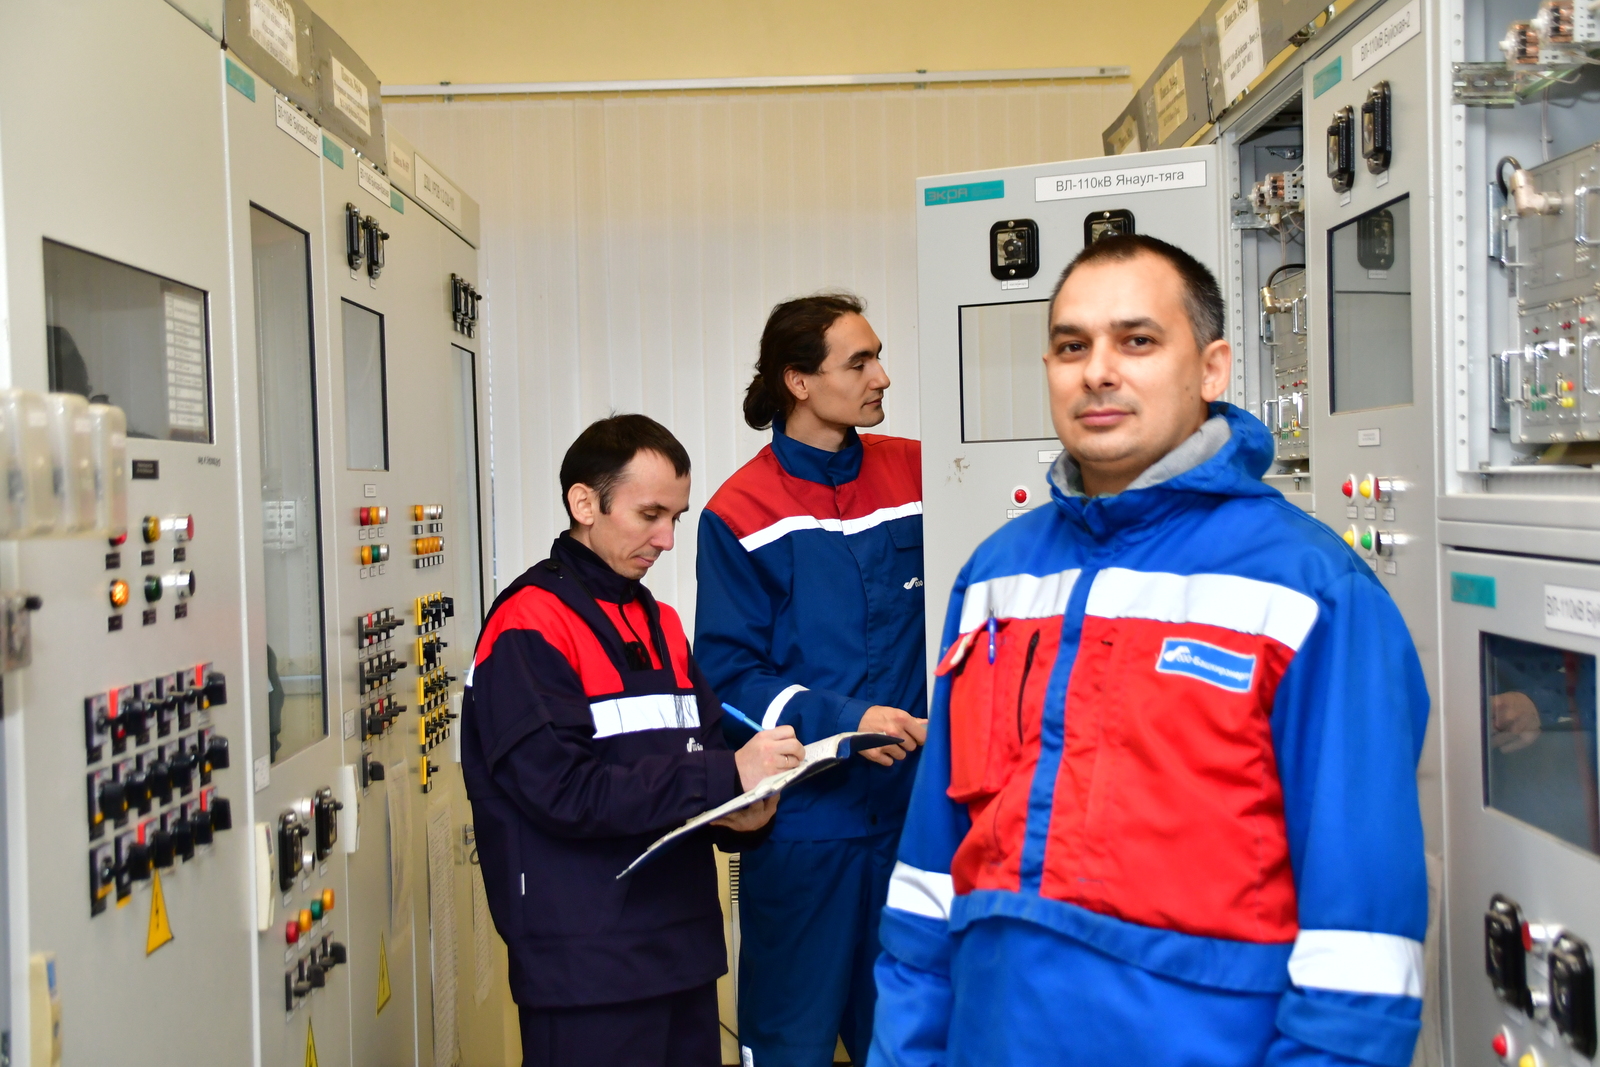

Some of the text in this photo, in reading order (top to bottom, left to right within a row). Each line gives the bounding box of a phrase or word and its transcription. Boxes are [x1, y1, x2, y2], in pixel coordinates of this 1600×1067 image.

[1361, 11, 1411, 61] ВЛ-110кВ Буйская-2
[1056, 171, 1184, 192] ВЛ-110кВ Янаул-тяга
[1546, 595, 1584, 622] ВЛ-110кВ
